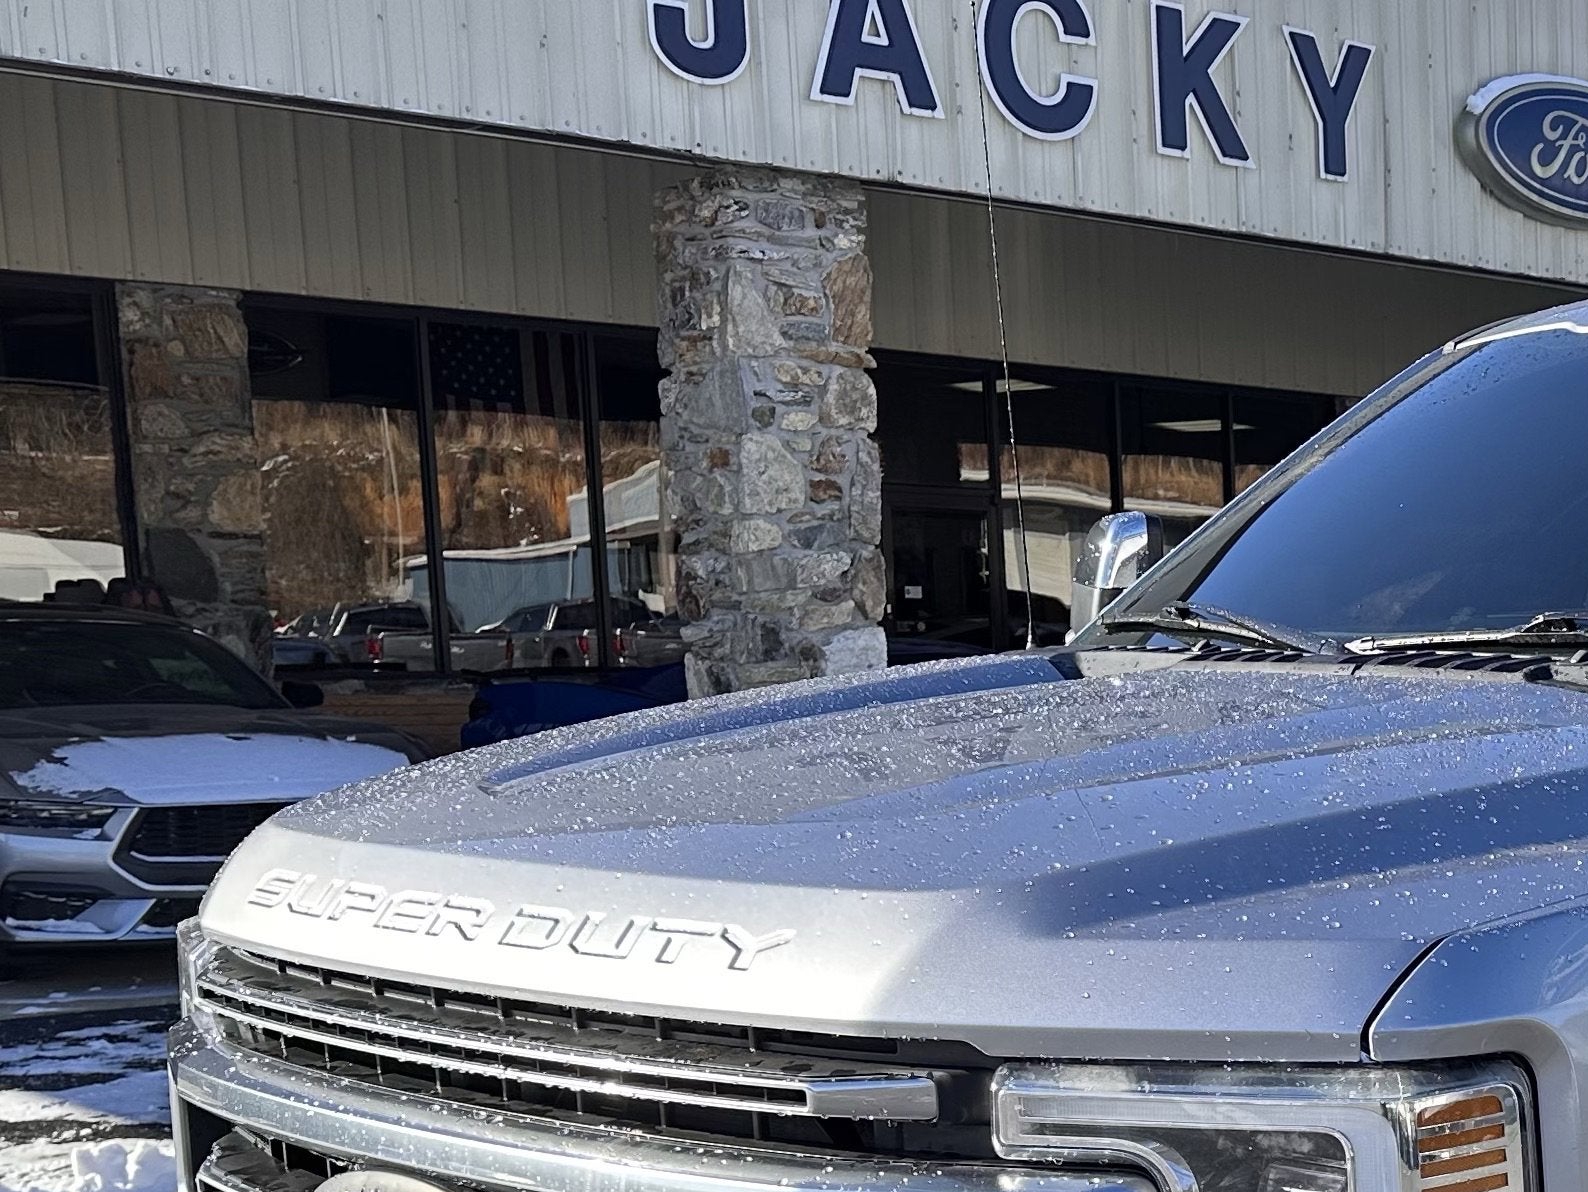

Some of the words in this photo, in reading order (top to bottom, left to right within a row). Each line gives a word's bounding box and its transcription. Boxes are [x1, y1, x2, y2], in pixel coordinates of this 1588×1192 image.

[647, 0, 1376, 183] JACKY
[246, 867, 495, 942] SUPER
[497, 902, 798, 972] DUTY
